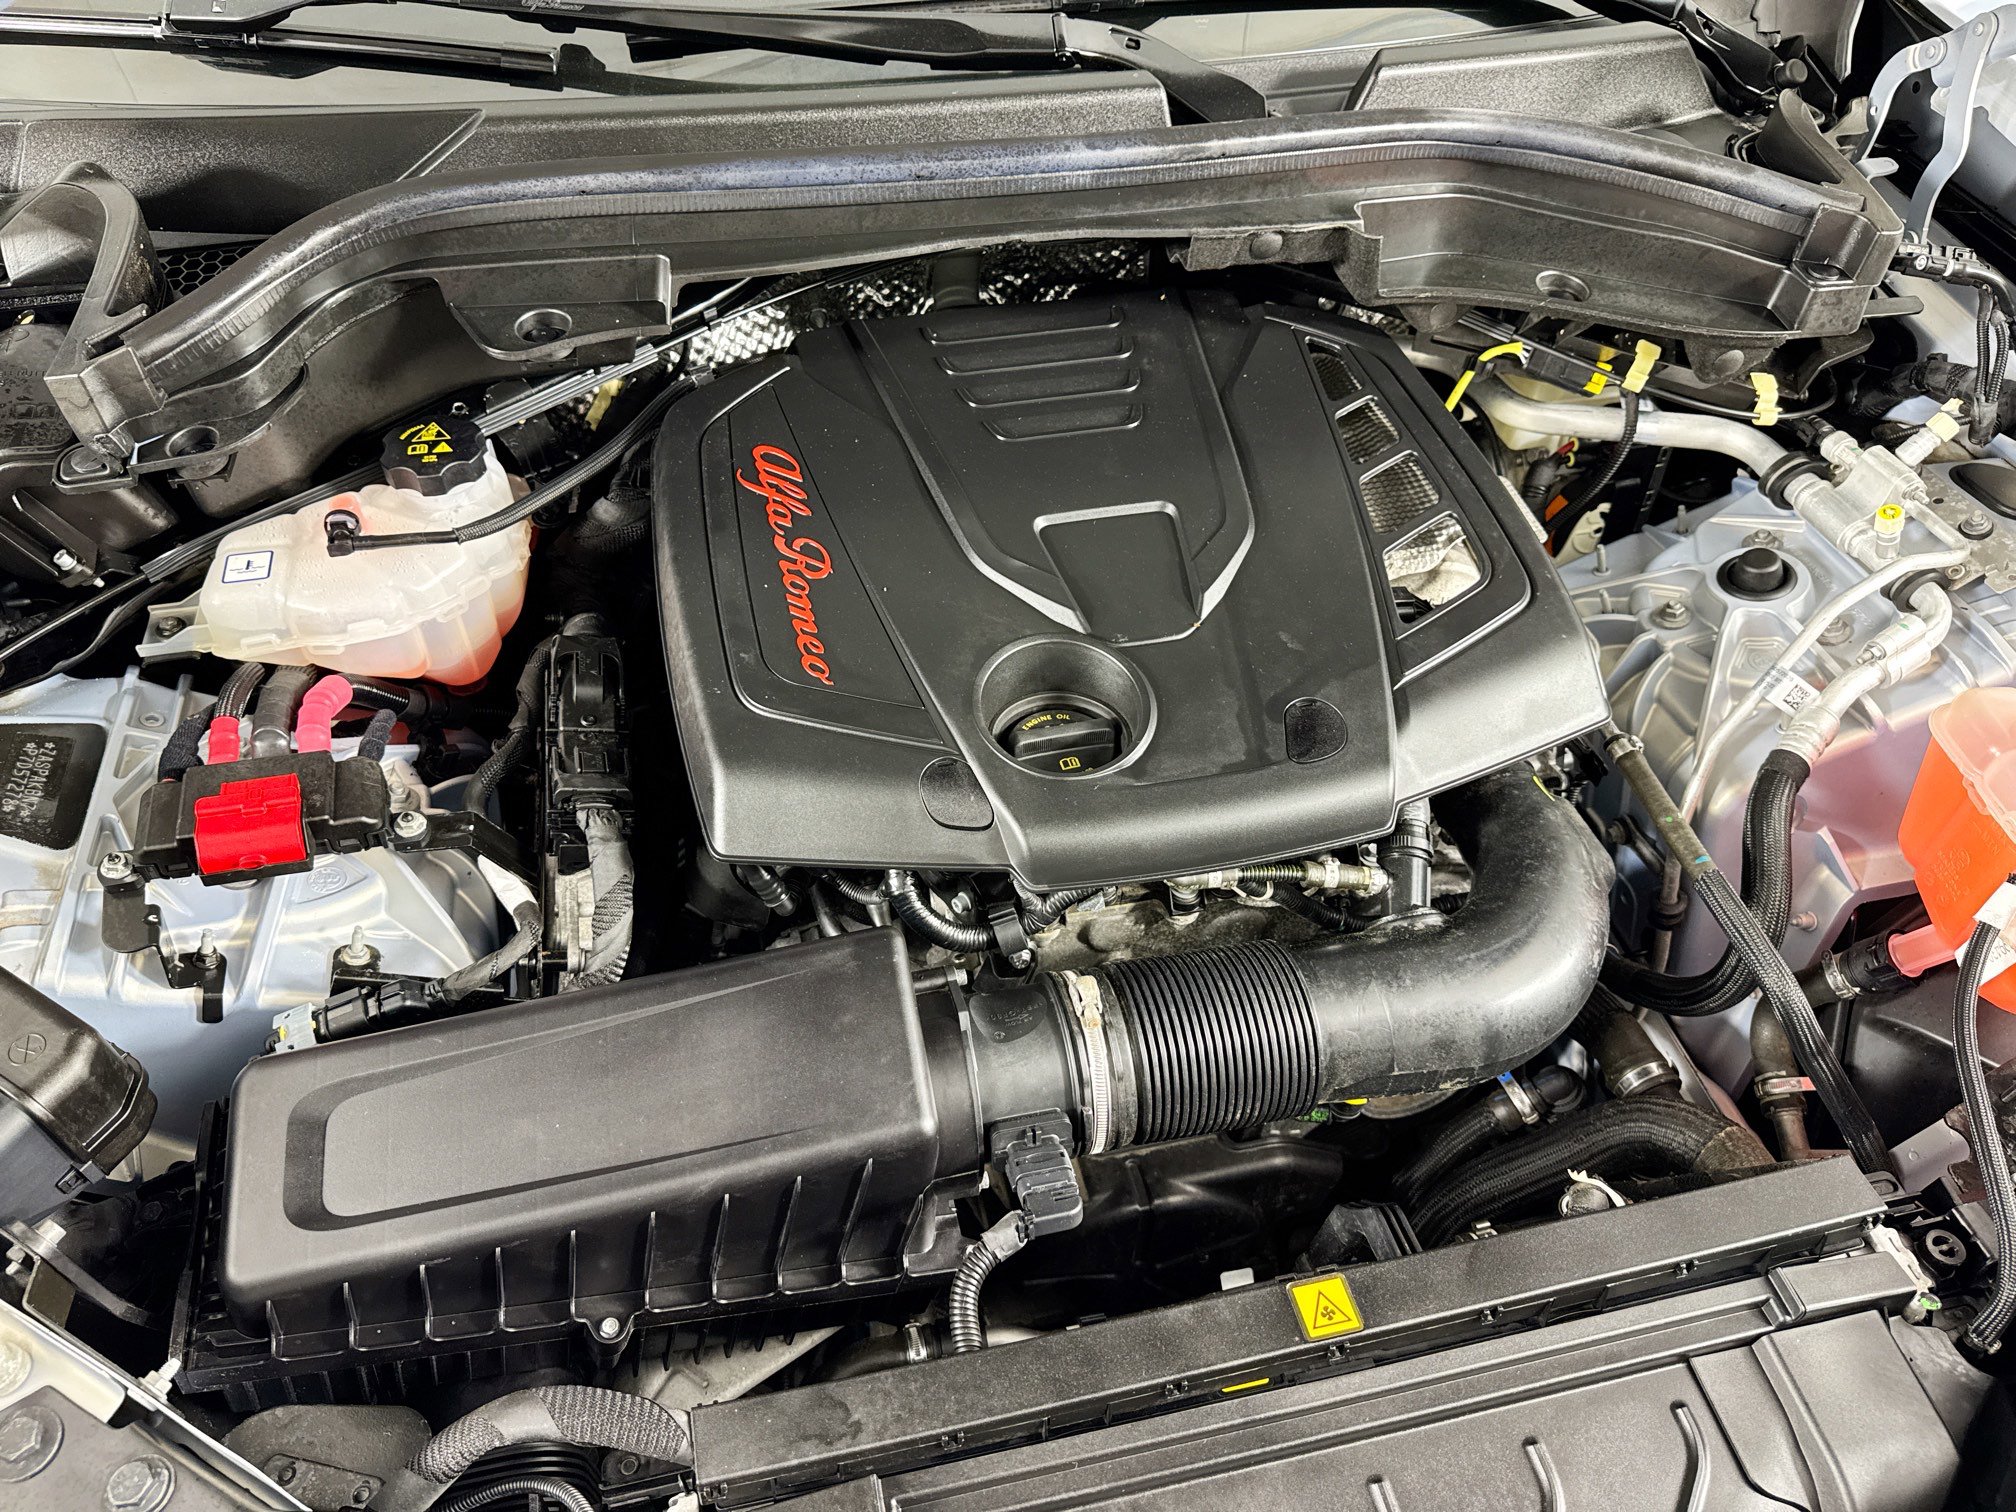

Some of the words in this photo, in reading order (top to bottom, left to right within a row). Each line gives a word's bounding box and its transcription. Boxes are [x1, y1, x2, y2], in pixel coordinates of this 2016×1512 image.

[736, 444, 812, 535] Alfa
[774, 533, 834, 686] Romeo
[1022, 714, 1053, 731] ENGINE
